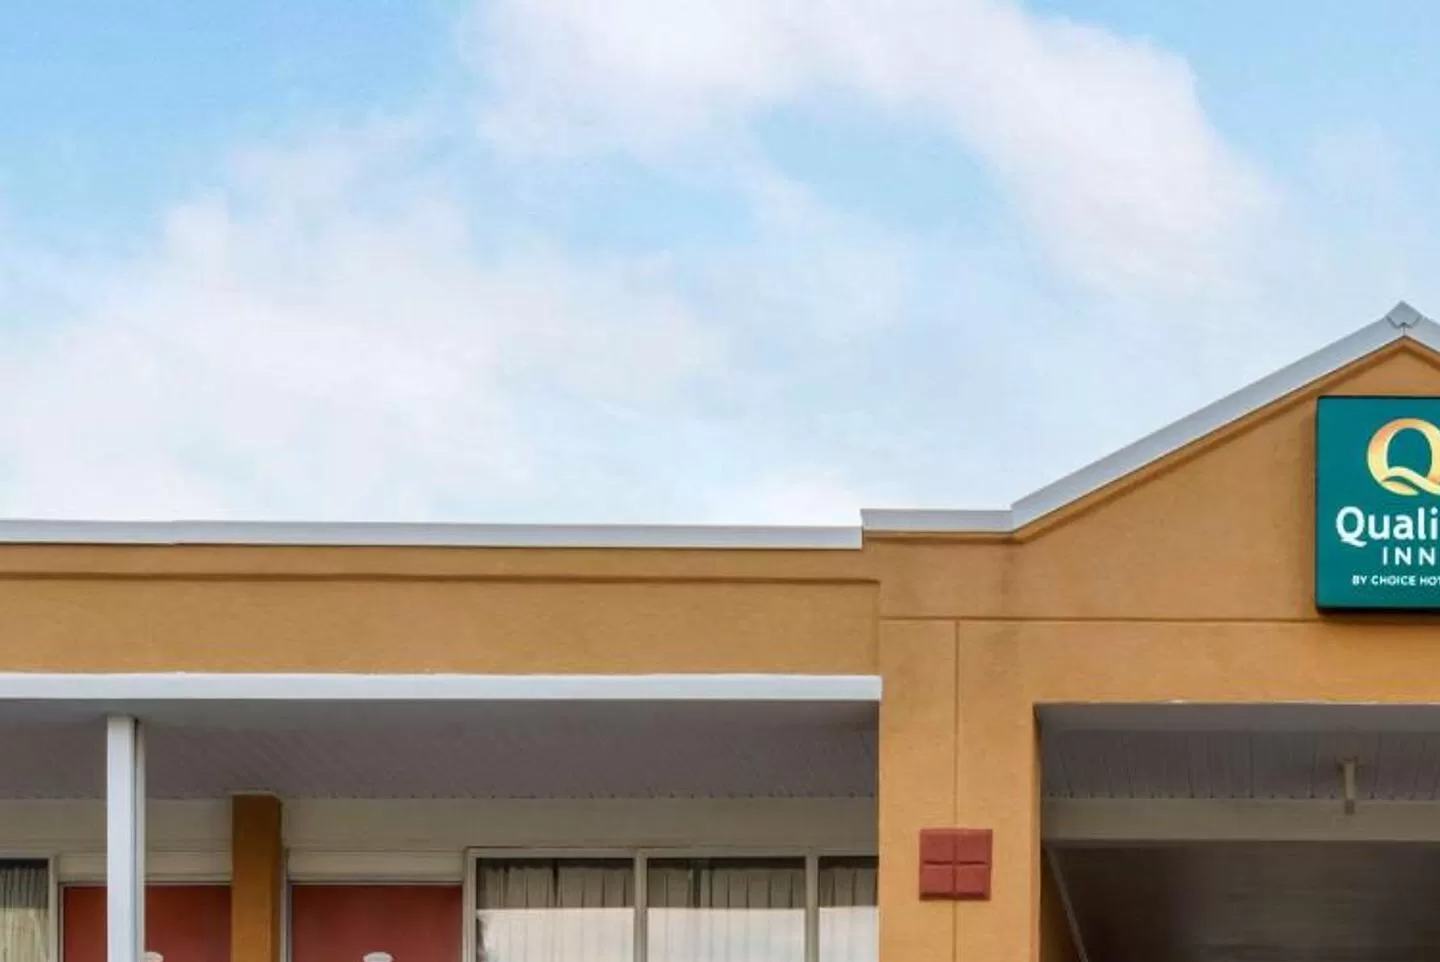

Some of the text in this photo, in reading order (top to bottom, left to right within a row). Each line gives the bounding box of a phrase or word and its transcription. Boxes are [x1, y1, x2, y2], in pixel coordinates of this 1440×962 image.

[1382, 546, 1436, 566] INN
[1352, 575, 1367, 586] BY
[1371, 575, 1416, 586] CHOICE
